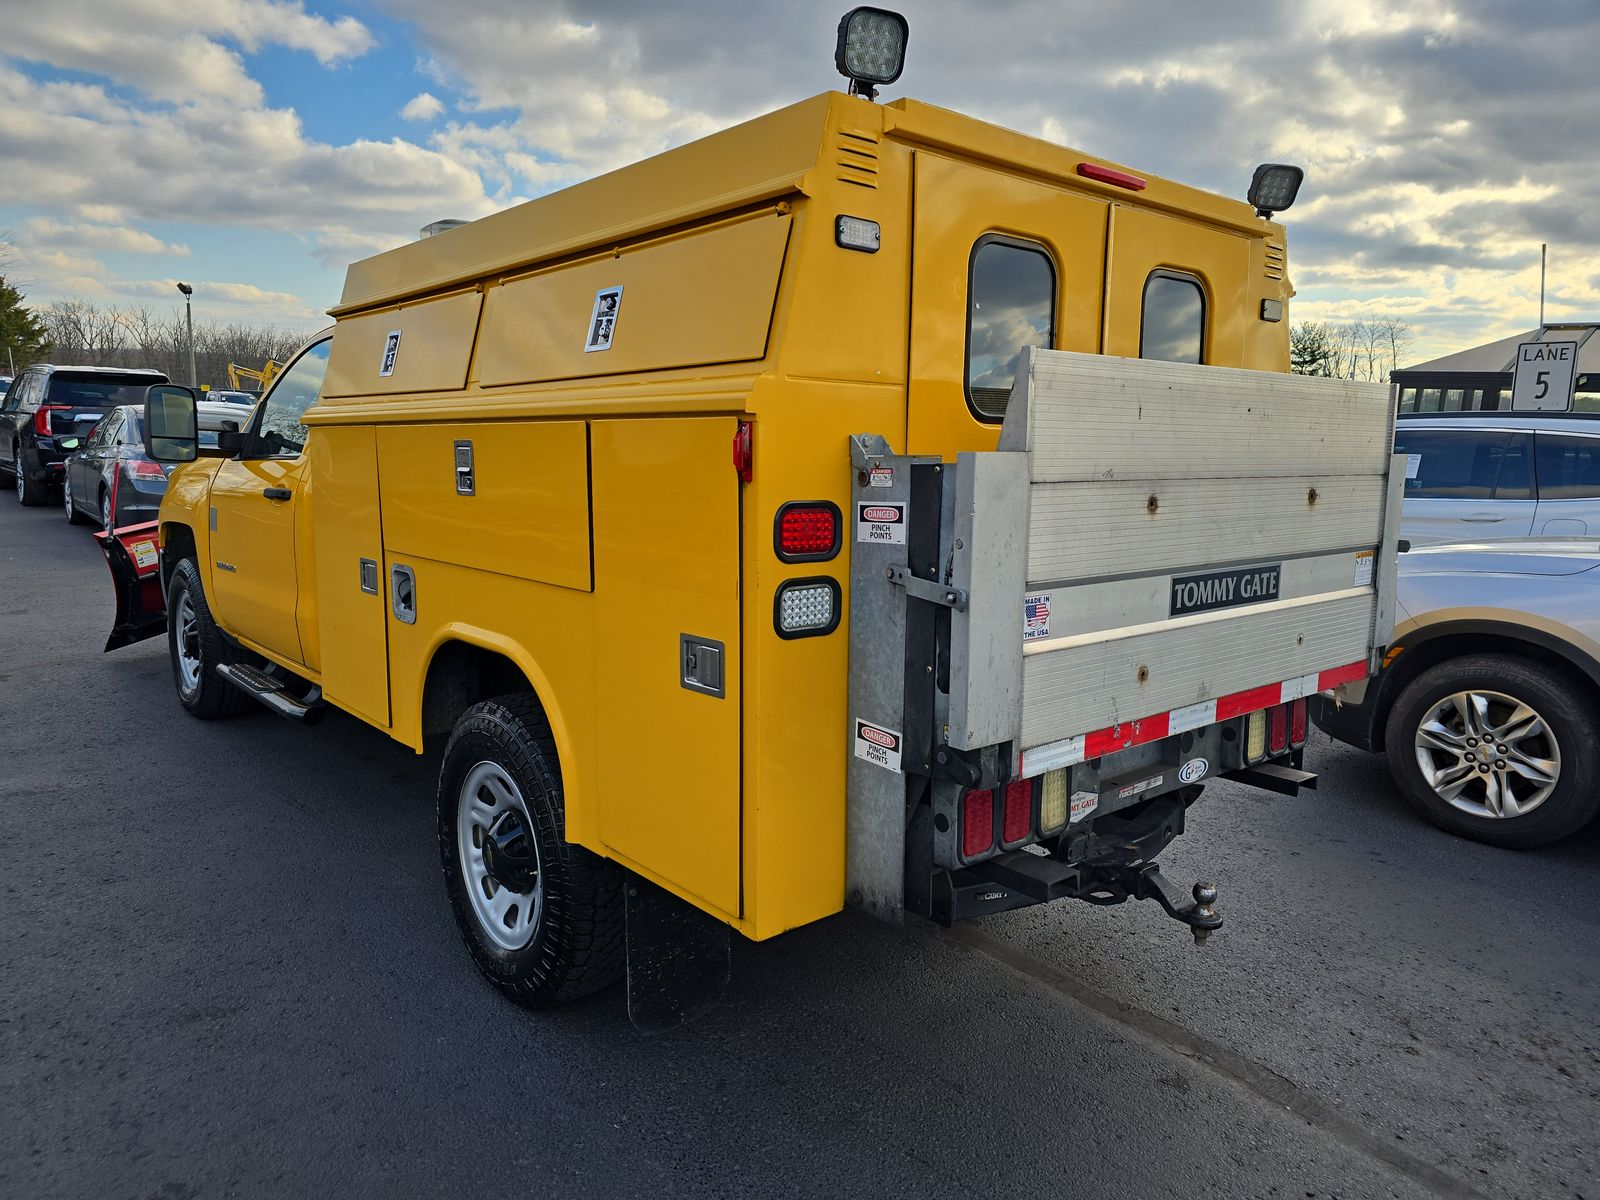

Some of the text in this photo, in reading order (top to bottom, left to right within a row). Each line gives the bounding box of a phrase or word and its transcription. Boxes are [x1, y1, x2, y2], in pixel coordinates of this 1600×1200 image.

[1523, 347, 1570, 362] LANE
[1534, 371, 1551, 400] 5
[867, 510, 895, 519] DANGER
[871, 523, 891, 532] PINCH
[869, 532, 892, 540] POINTS
[1174, 571, 1278, 609] TOMMY GATE
[1043, 595, 1050, 603] IN
[1024, 628, 1049, 638] THE USA
[865, 729, 891, 746] DANGER
[868, 744, 887, 757] PINCH
[866, 750, 888, 765] POINTS
[1081, 798, 1095, 809] GATE
[984, 892, 1004, 900] CURT
